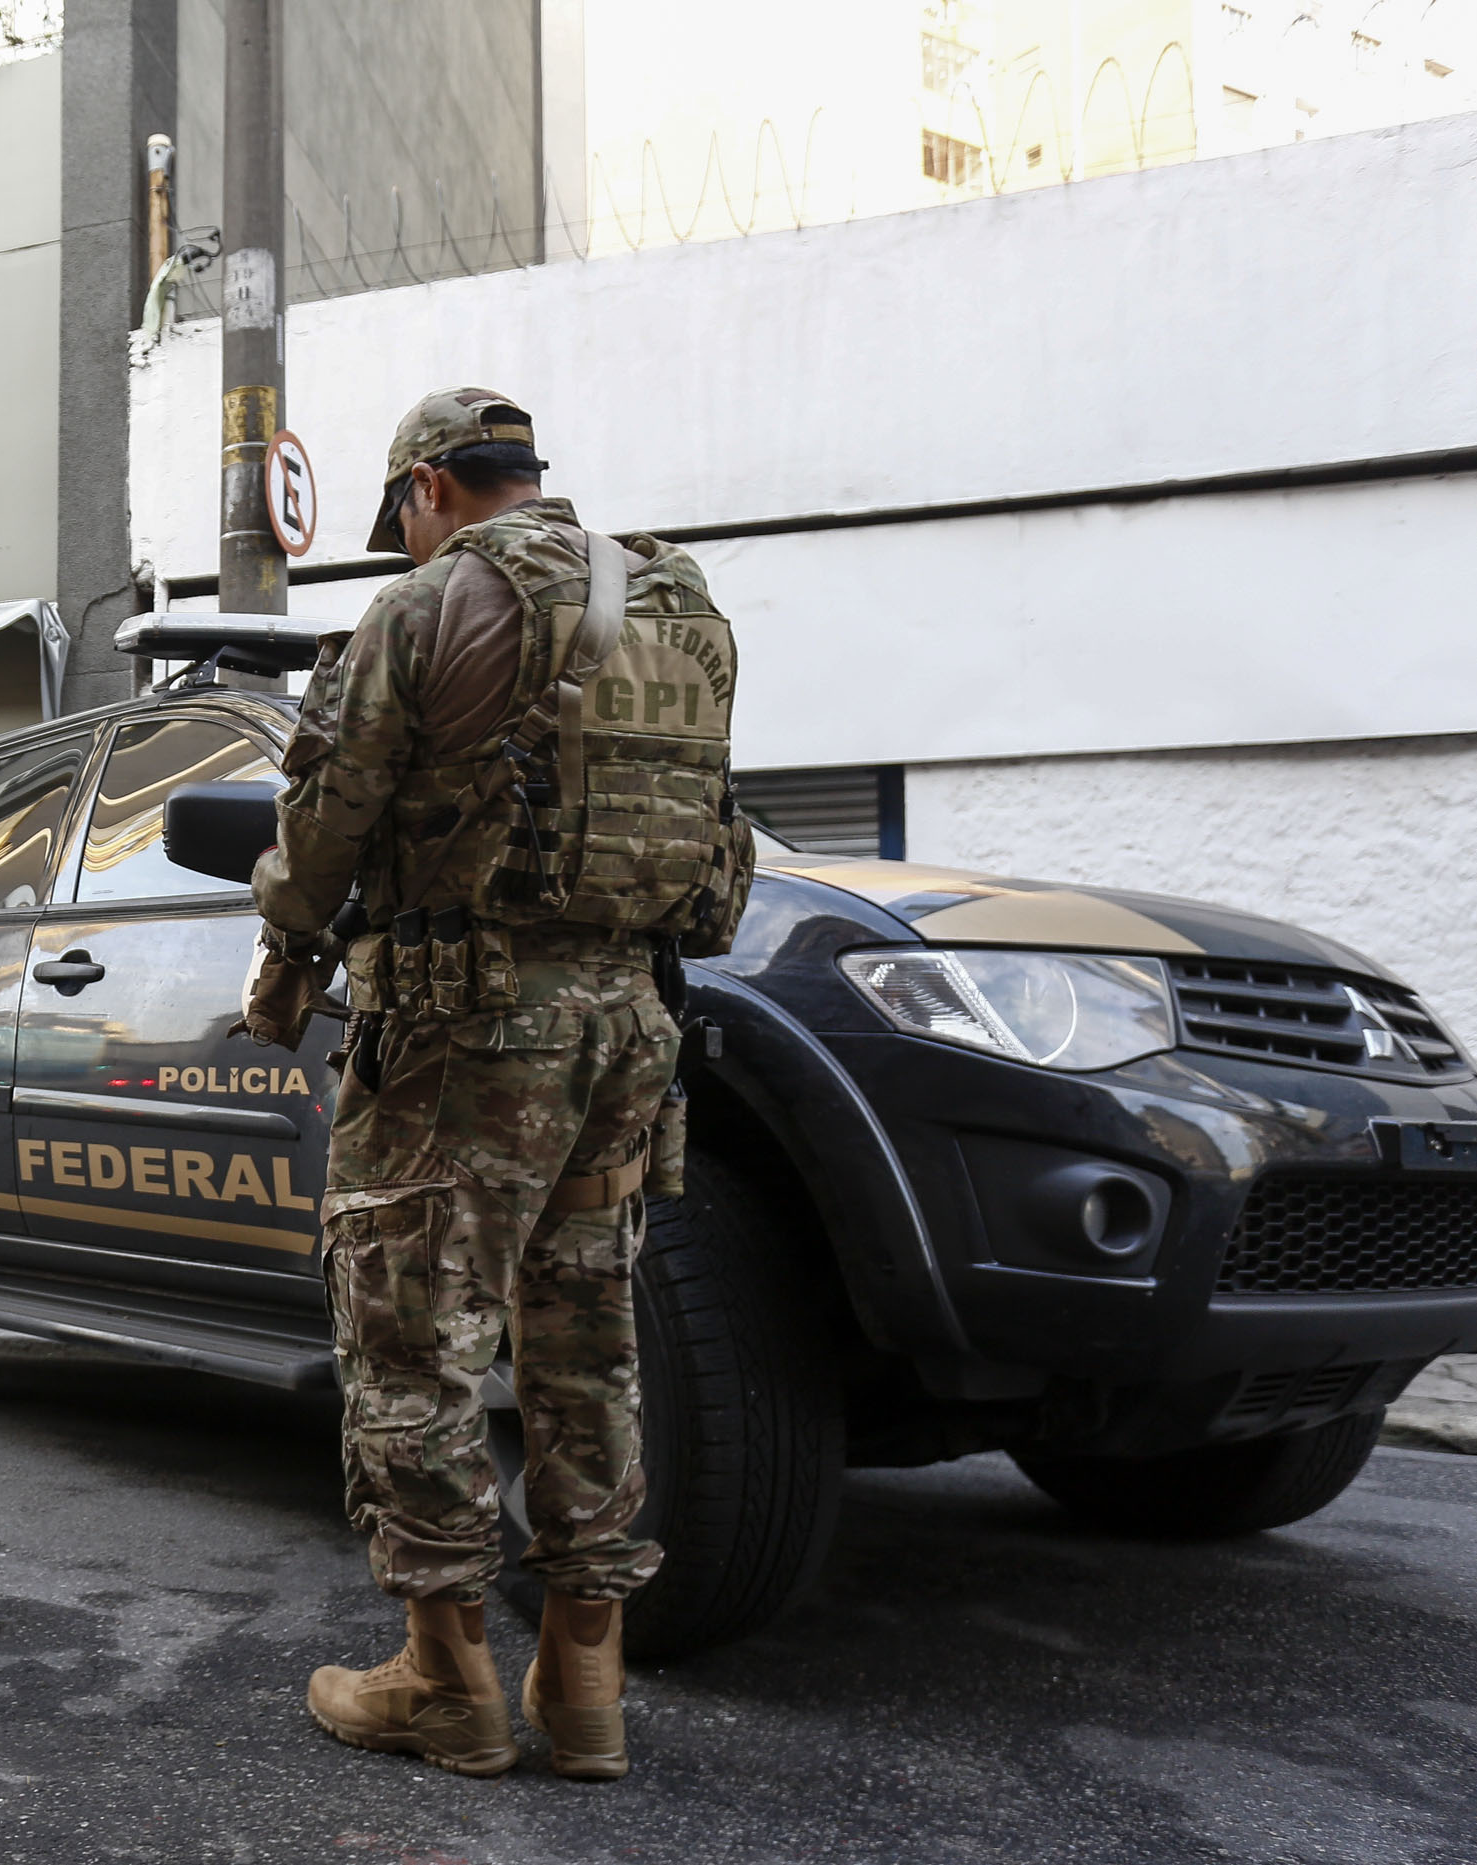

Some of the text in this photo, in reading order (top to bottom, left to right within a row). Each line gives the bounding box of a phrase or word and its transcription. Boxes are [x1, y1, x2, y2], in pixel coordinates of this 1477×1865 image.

[655, 619, 731, 708] FEDERAL
[594, 676, 700, 726] GPI
[17, 1138, 315, 1212] FEDERAL
